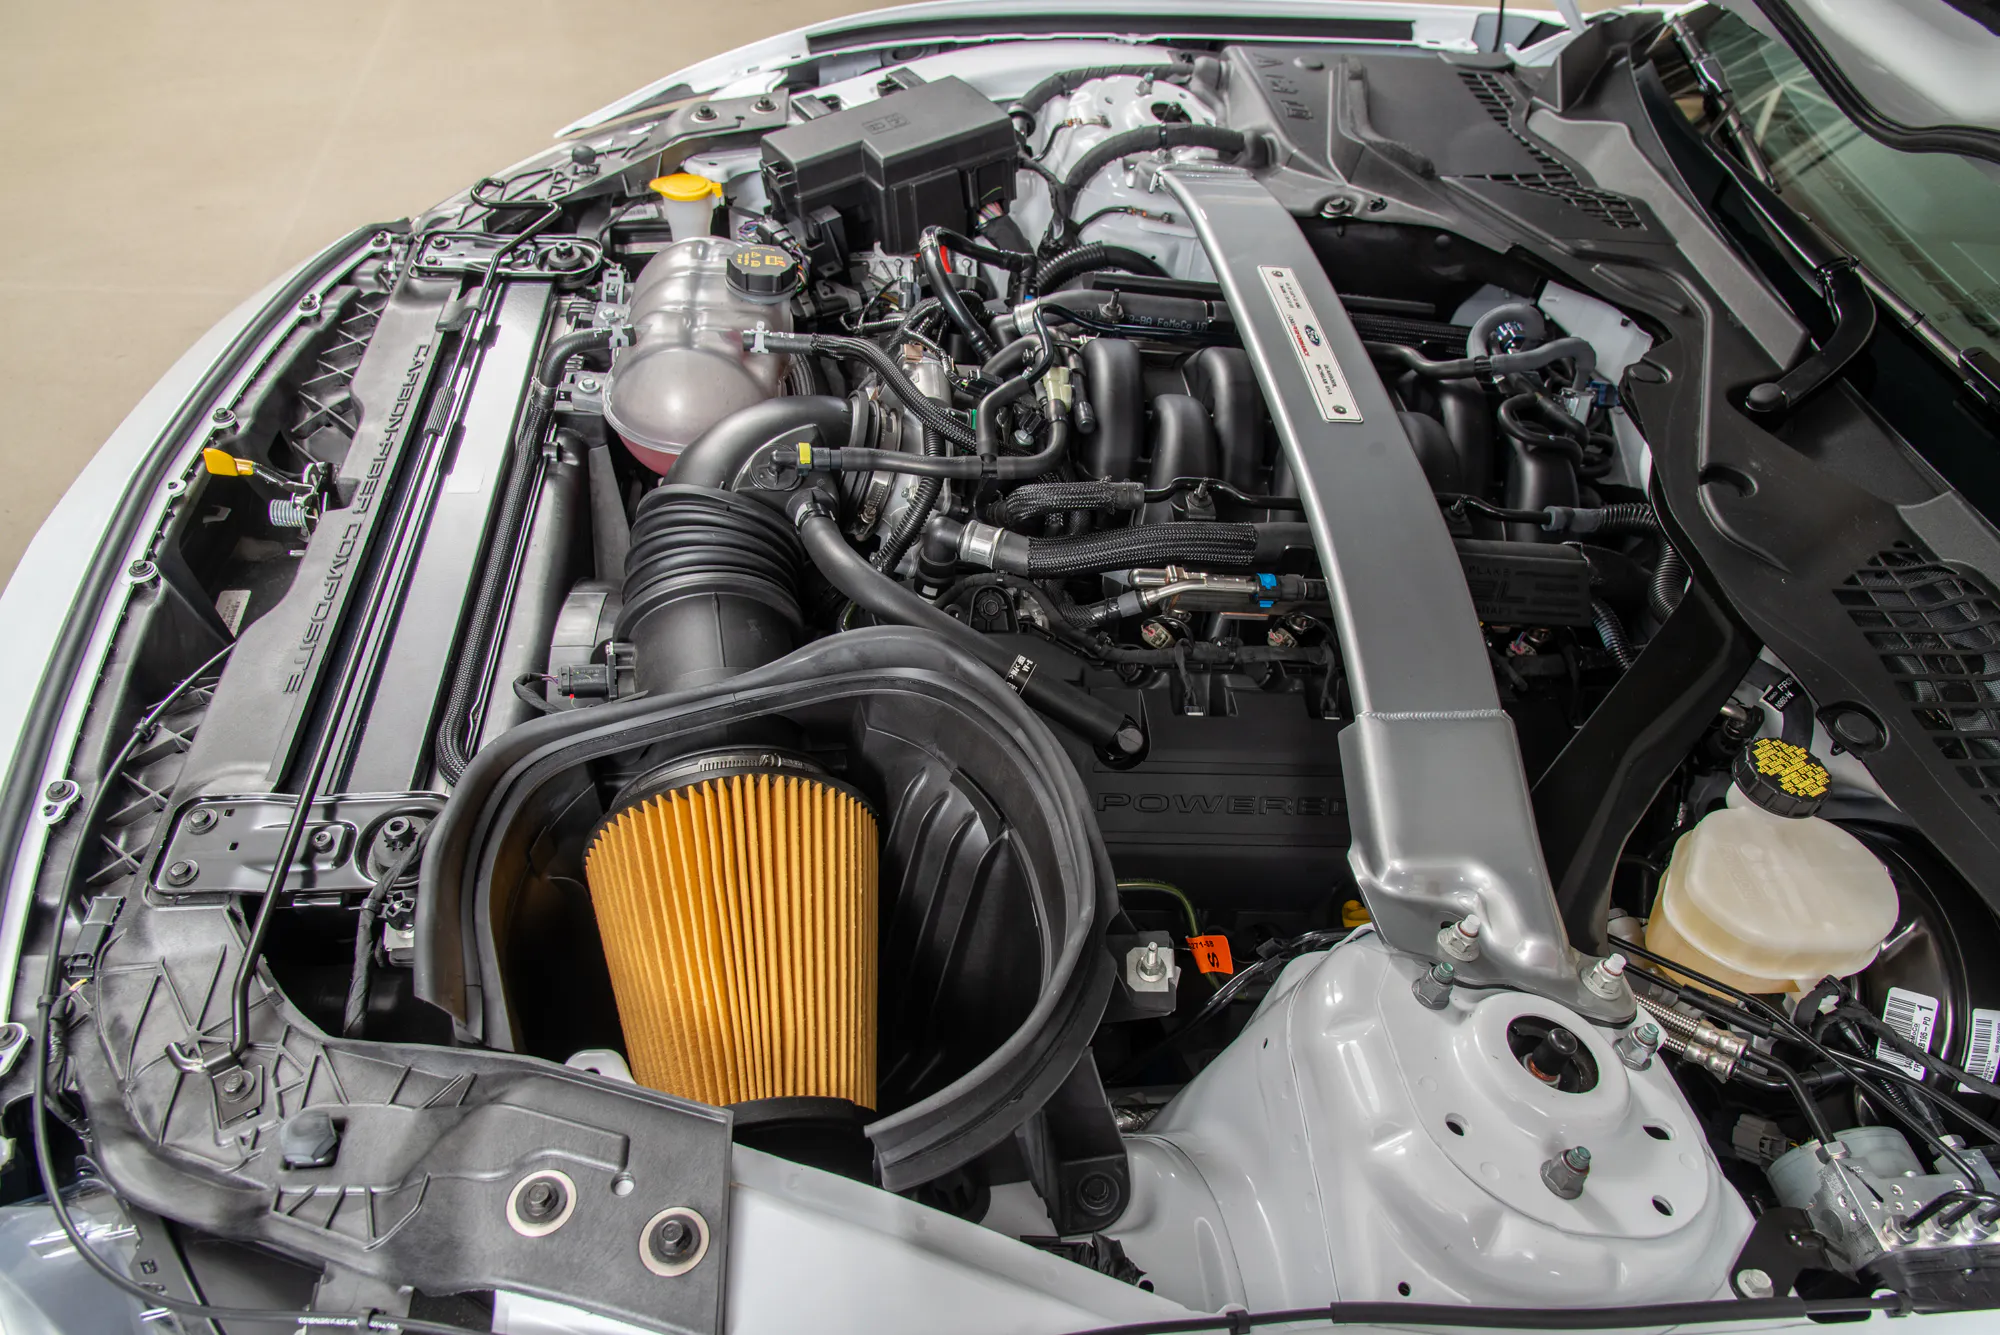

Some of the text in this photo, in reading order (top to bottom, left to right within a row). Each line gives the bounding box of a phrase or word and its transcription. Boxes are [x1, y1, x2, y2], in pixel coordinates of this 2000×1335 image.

[282, 343, 431, 695] CARBON-FIBER COMPOSITE
[1917, 1004, 1934, 1012] 1
